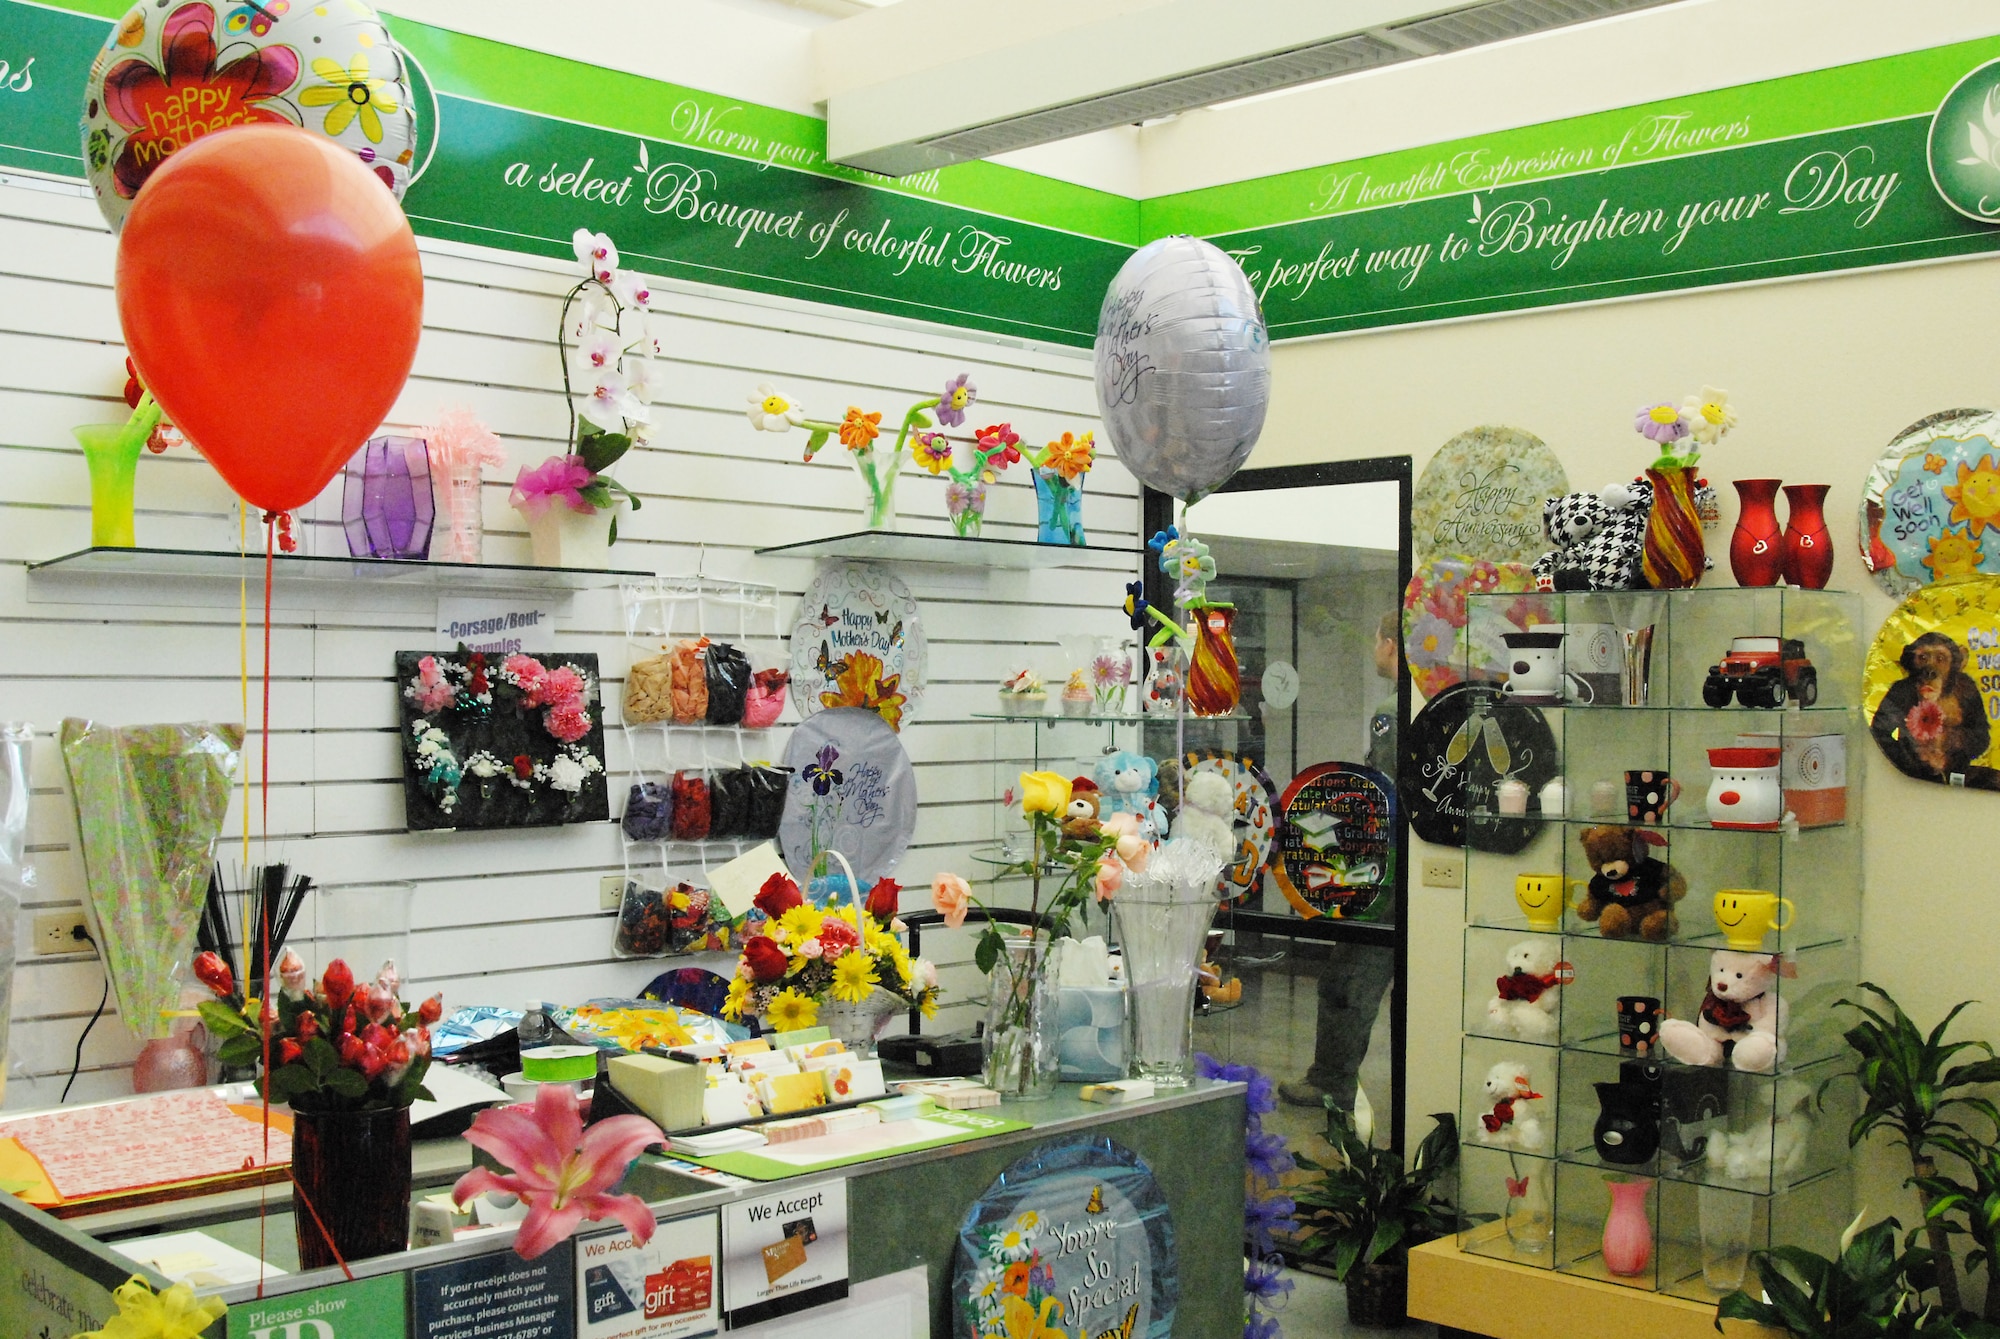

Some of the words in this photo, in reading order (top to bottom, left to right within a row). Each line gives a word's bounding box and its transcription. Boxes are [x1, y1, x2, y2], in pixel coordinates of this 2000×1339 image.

[671, 100, 760, 151] Warm
[757, 140, 819, 171] your
[1305, 171, 1362, 212] A
[1356, 162, 1446, 208] heartfelt
[1450, 147, 1594, 194] Expression
[1600, 128, 1634, 174] of
[1633, 111, 1751, 156] Flowers
[900, 167, 940, 194] with
[504, 162, 533, 188] a
[539, 157, 633, 206] select
[644, 162, 803, 248] Bouquet
[805, 208, 849, 260] of
[843, 219, 951, 276] colorful
[952, 224, 1062, 291] Flowers
[1259, 241, 1360, 304] perfect
[1365, 243, 1433, 291] way
[1440, 232, 1473, 263] to
[1478, 196, 1669, 270] Brighten
[1661, 191, 1771, 256] your
[1778, 145, 1902, 229] Day
[1455, 464, 1536, 516] Happy
[1433, 504, 1541, 548] Anniversary
[842, 608, 872, 631] Happy
[831, 630, 869, 649] Mother's
[871, 632, 891, 656] Day
[748, 1204, 771, 1223] We
[776, 1192, 824, 1217] Accept
[585, 1244, 606, 1258] We
[1050, 1218, 1119, 1260] You're
[440, 1285, 449, 1297] If
[450, 1282, 472, 1297] your
[474, 1274, 507, 1289] receipt
[508, 1271, 530, 1281] does
[531, 1265, 547, 1276] not
[1083, 1249, 1110, 1287] So
[443, 1292, 493, 1312] accurately
[494, 1285, 523, 1299] match
[524, 1282, 546, 1297] your
[594, 1291, 616, 1313] gift
[645, 1284, 675, 1313] gift
[1064, 1261, 1142, 1328] Special
[249, 1309, 302, 1329] Please
[307, 1298, 347, 1317] show
[428, 1312, 475, 1332] purchase,
[476, 1304, 507, 1322] please
[507, 1297, 542, 1312] contact
[544, 1293, 559, 1303] the
[474, 1319, 514, 1336] Business
[515, 1309, 556, 1326] Manager
